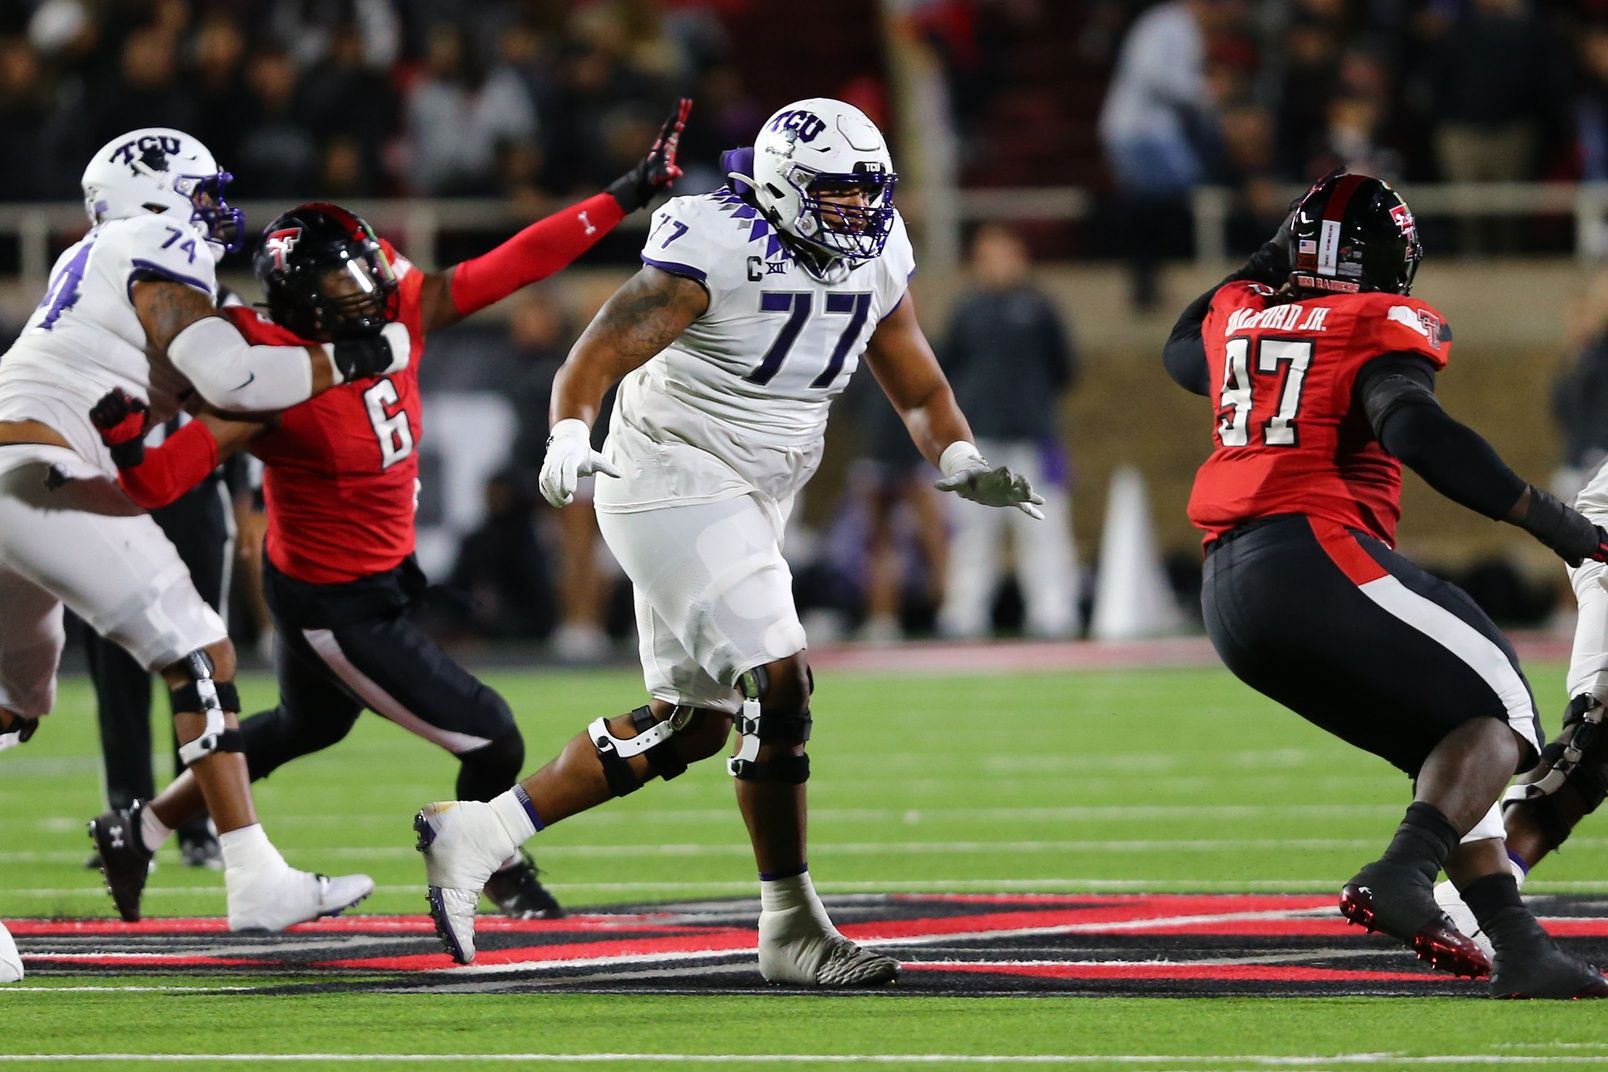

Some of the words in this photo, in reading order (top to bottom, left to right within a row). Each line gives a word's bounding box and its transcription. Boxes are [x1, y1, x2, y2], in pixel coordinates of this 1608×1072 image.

[767, 110, 826, 143] TCU
[109, 136, 181, 165] TCU
[864, 162, 881, 172] TCU
[161, 226, 197, 264] 74
[650, 212, 690, 250] 77
[747, 256, 763, 282] C
[740, 290, 874, 389] 77
[1216, 336, 1315, 448] 97
[363, 376, 414, 472] 6
